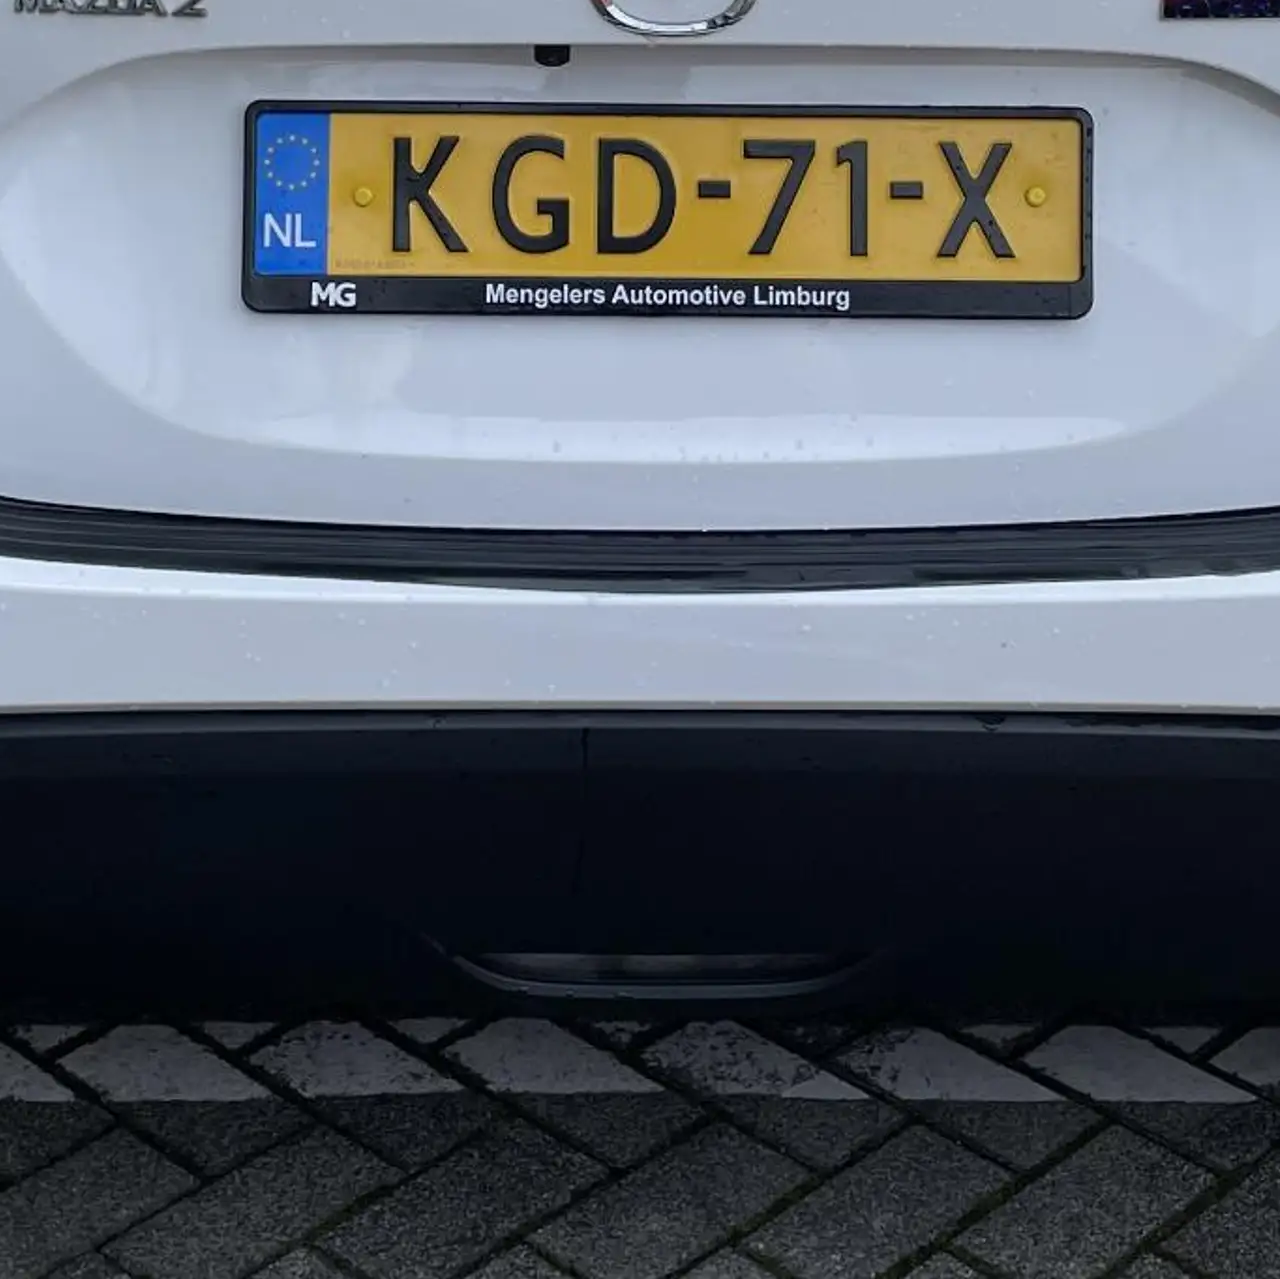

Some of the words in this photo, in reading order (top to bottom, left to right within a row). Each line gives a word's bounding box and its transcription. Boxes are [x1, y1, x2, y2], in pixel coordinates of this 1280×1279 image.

[392, 135, 1015, 258] KGD-71-X
[263, 213, 317, 248] NL
[311, 282, 356, 307] MG
[485, 284, 606, 308] Mengelers
[612, 285, 746, 306] Automotive
[753, 287, 850, 311] Limburg
